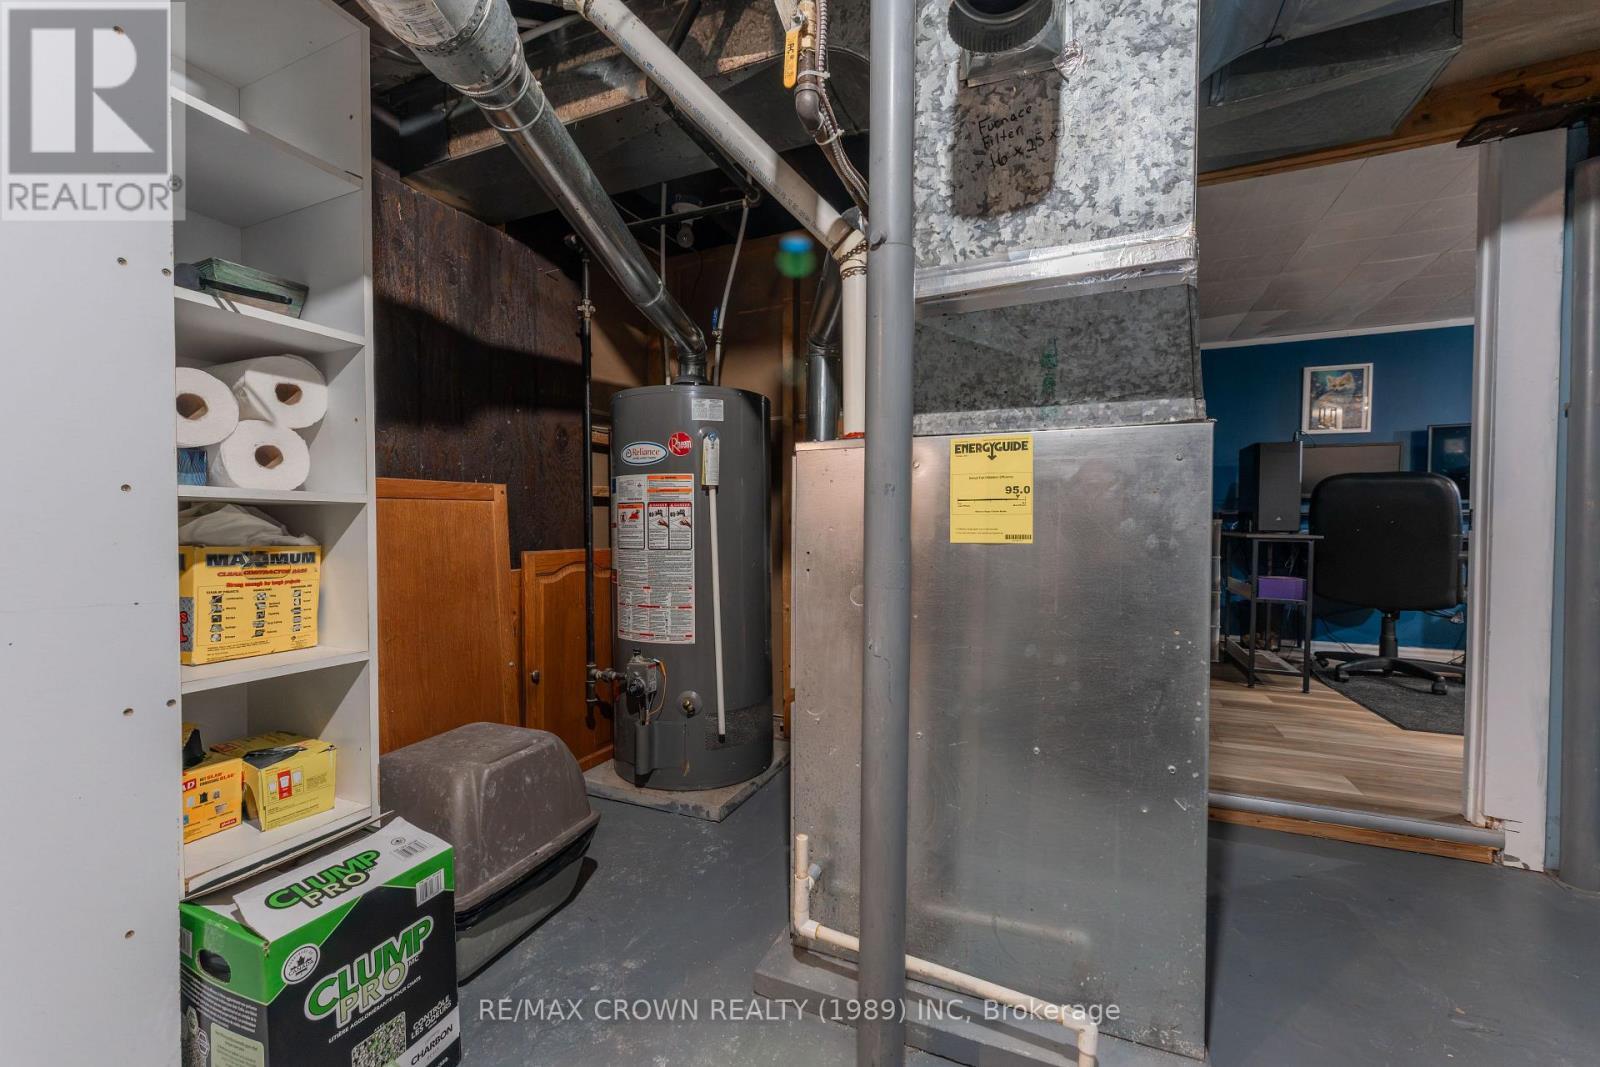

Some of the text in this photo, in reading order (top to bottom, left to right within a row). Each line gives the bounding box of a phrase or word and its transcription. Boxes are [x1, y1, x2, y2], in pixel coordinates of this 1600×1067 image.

[978, 105, 1032, 135] Furnace
[990, 153, 1008, 169] 16
[1026, 132, 1045, 153] 25
[632, 447, 660, 456] Reliance
[671, 432, 692, 453] Rheem
[1005, 485, 1031, 494] 95.0
[265, 850, 381, 909] CLUMP
[301, 871, 370, 908] PRO
[304, 916, 434, 1021] CLUMP
[336, 962, 408, 1028] PRO
[411, 1026, 424, 1039] LES
[411, 1024, 454, 1066] CHARBON
